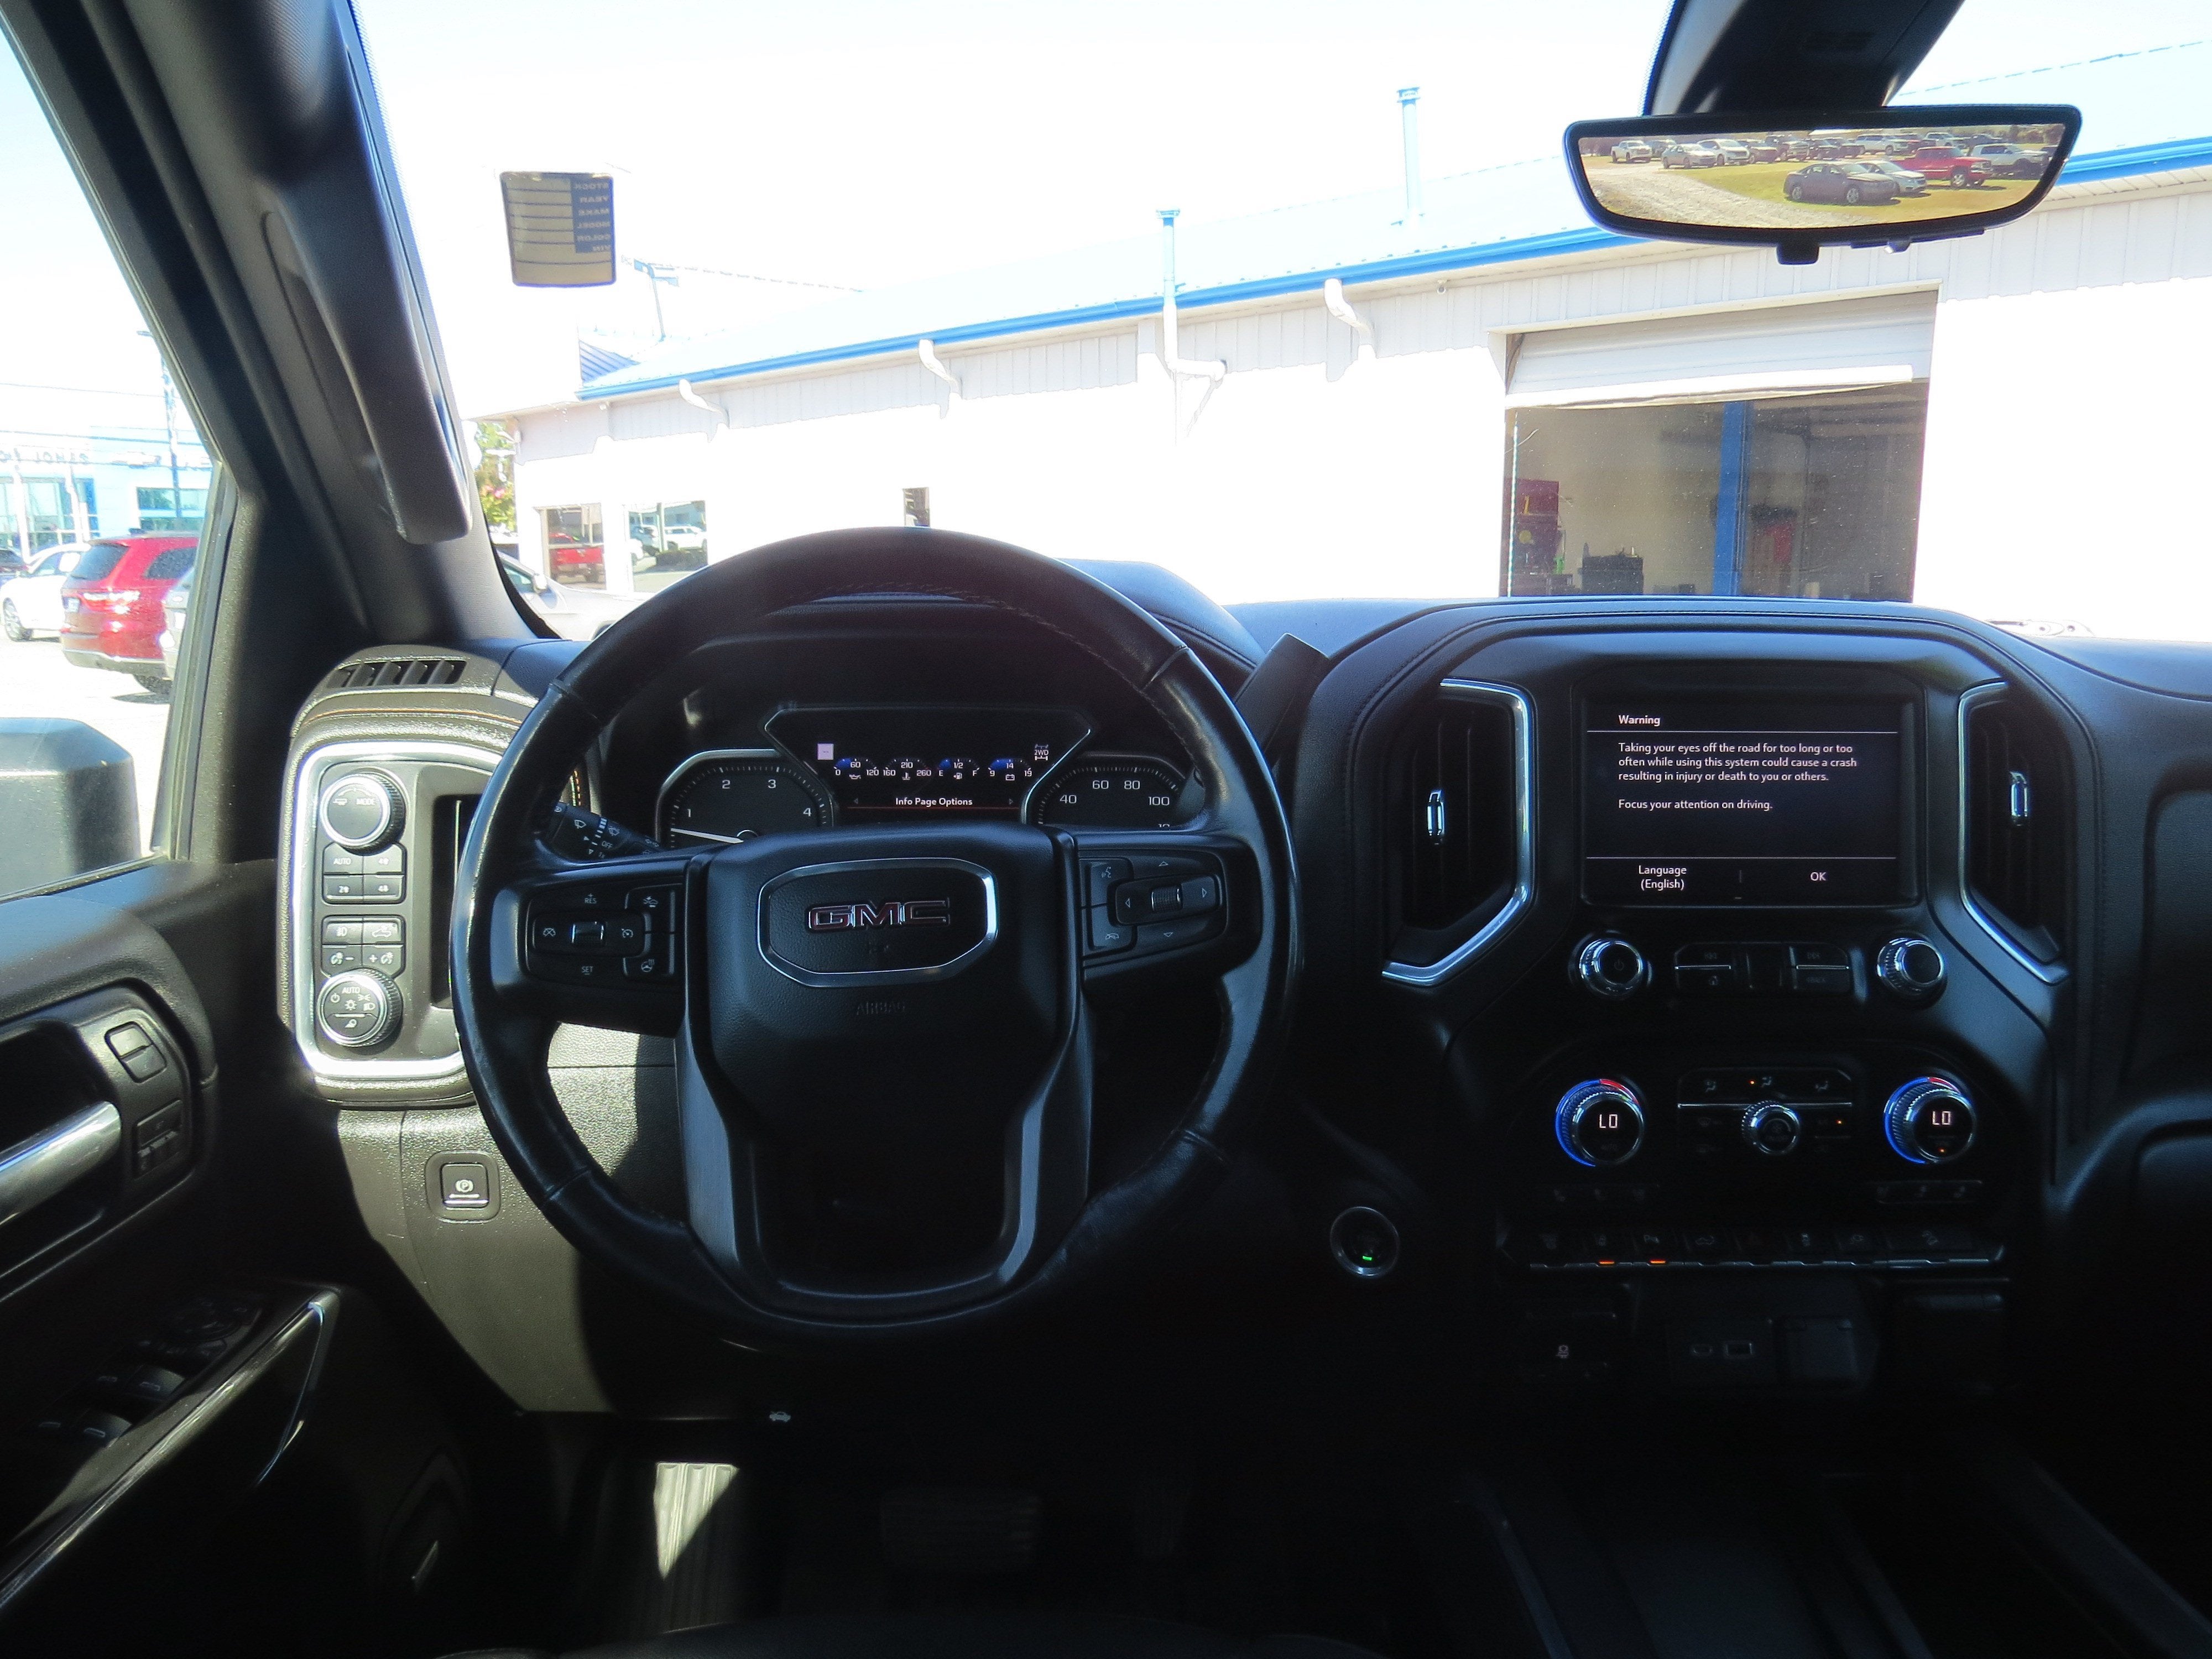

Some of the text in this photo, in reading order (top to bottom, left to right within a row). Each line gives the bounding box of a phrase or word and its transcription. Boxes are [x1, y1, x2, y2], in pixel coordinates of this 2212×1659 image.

[1618, 714, 1660, 727] Warning
[1618, 743, 1651, 754] Taking
[1652, 745, 1676, 755] your
[1678, 745, 1700, 755] eyes
[1702, 743, 1717, 753] off
[1719, 743, 1735, 753] the
[1738, 743, 1760, 753] road
[1762, 743, 1777, 753] for
[1780, 744, 1797, 753] too
[1798, 743, 1820, 755] long
[1836, 744, 1853, 753] too
[1618, 757, 1645, 766] often
[1647, 757, 1673, 766] while
[1676, 758, 1702, 769] using
[1704, 757, 1723, 766] this
[1725, 758, 1759, 769] system
[1761, 757, 1788, 767] could
[1830, 757, 1857, 767] crash
[1618, 771, 1662, 783] resulting
[1665, 771, 1673, 780] in
[1676, 771, 1703, 783] injury
[1718, 771, 1746, 781] death
[1749, 772, 1759, 781] to
[1761, 774, 1779, 784] you
[1794, 771, 1829, 781] others.
[722, 779, 731, 789] 2
[768, 779, 776, 789] 3
[1092, 780, 1109, 789] 60
[1124, 780, 1140, 790] 80
[895, 797, 973, 807] Info Page Options
[1060, 795, 1077, 804] 40
[1149, 796, 1170, 806] 100
[1618, 800, 1648, 809] Focus
[1650, 802, 1672, 811] your
[1674, 800, 1719, 809] attention
[1736, 799, 1773, 812] driving.
[687, 808, 691, 817] 1
[803, 807, 812, 817] 4
[1639, 865, 1687, 877] Language
[1810, 872, 1826, 881] OK
[1641, 878, 1684, 891] (English)
[808, 897, 950, 929] GMC
[1598, 1114, 1619, 1129] LO
[1932, 1110, 1952, 1126] LO
